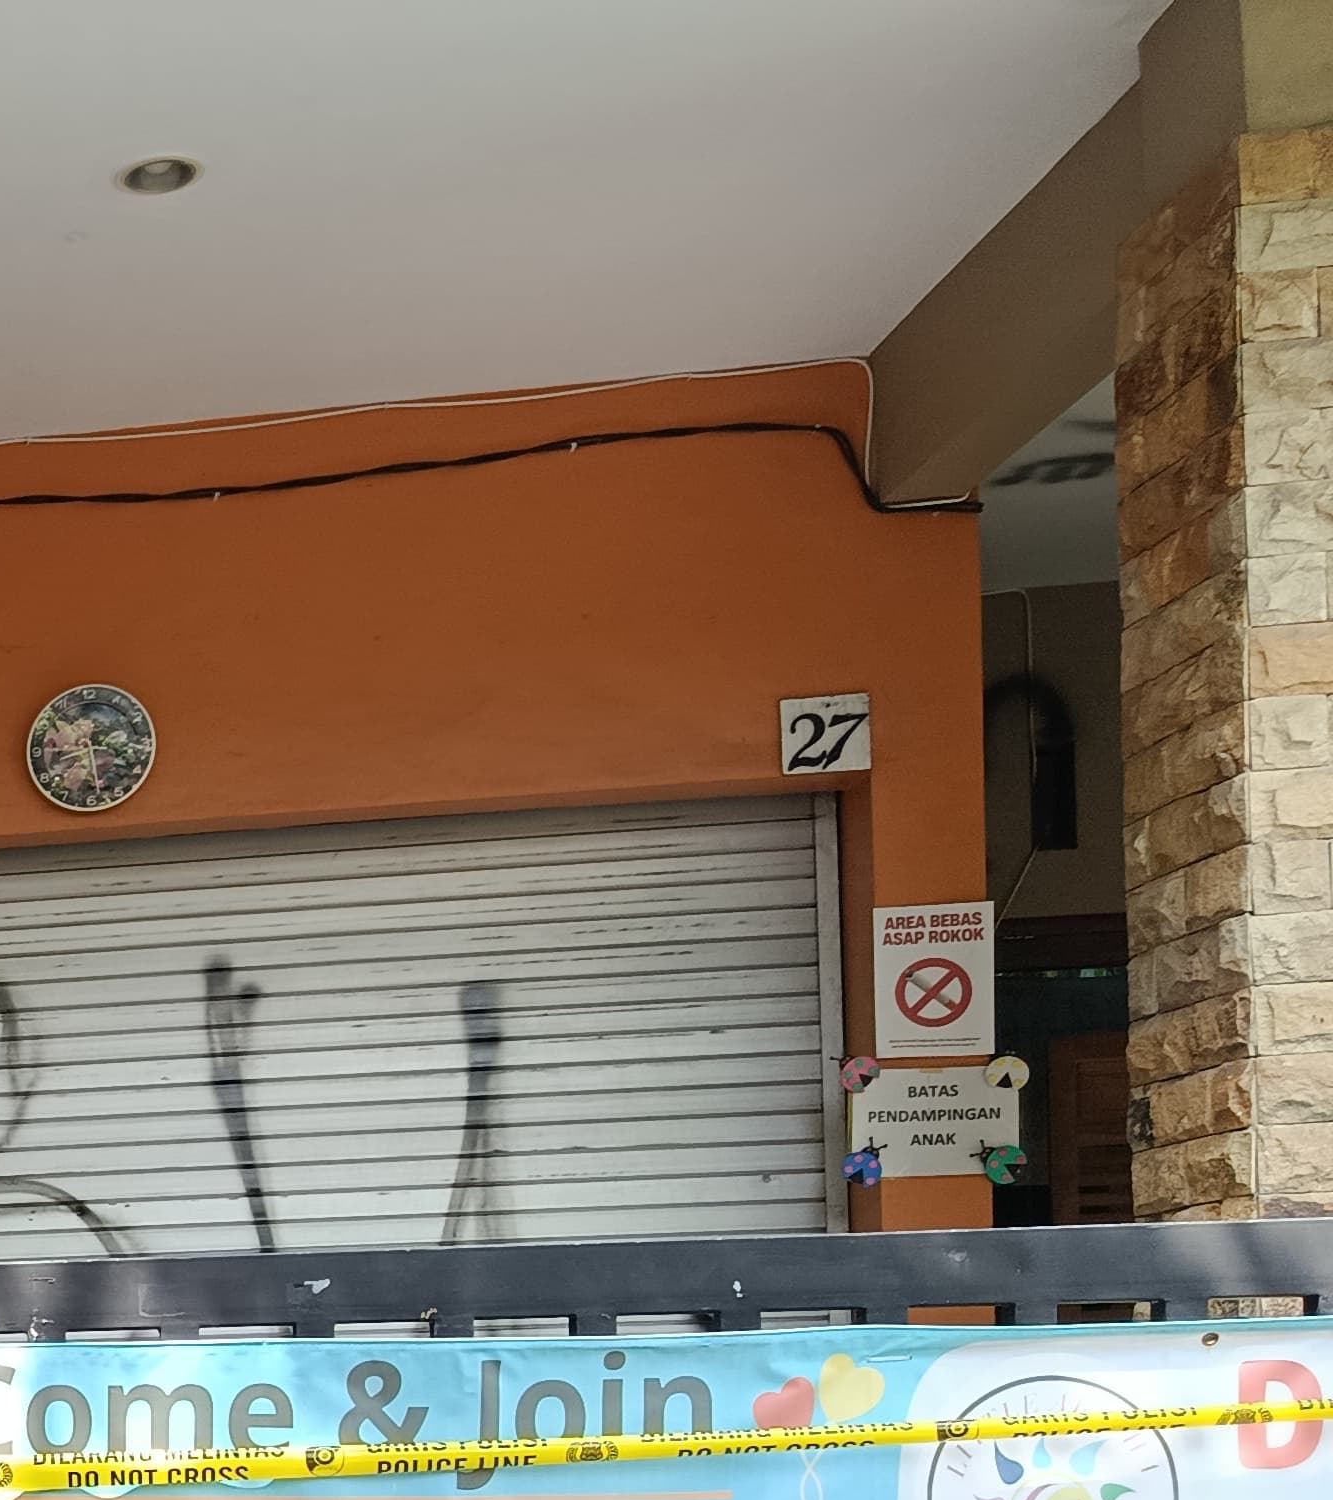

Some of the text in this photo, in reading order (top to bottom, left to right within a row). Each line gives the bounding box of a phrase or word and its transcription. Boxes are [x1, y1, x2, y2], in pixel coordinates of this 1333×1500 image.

[788, 712, 870, 772] 27
[86, 795, 97, 806] 6
[885, 912, 983, 930] AREA BEBAS
[883, 927, 985, 946] ASAP ROKOK
[908, 1084, 959, 1098] BATAS
[868, 1107, 1001, 1123] PENDAMPINGAN
[910, 1133, 957, 1146] ANAK
[339, 1360, 429, 1445] &
[457, 1350, 713, 1490] Join
[68, 1470, 99, 1488] DO
[110, 1468, 158, 1486] NOT
